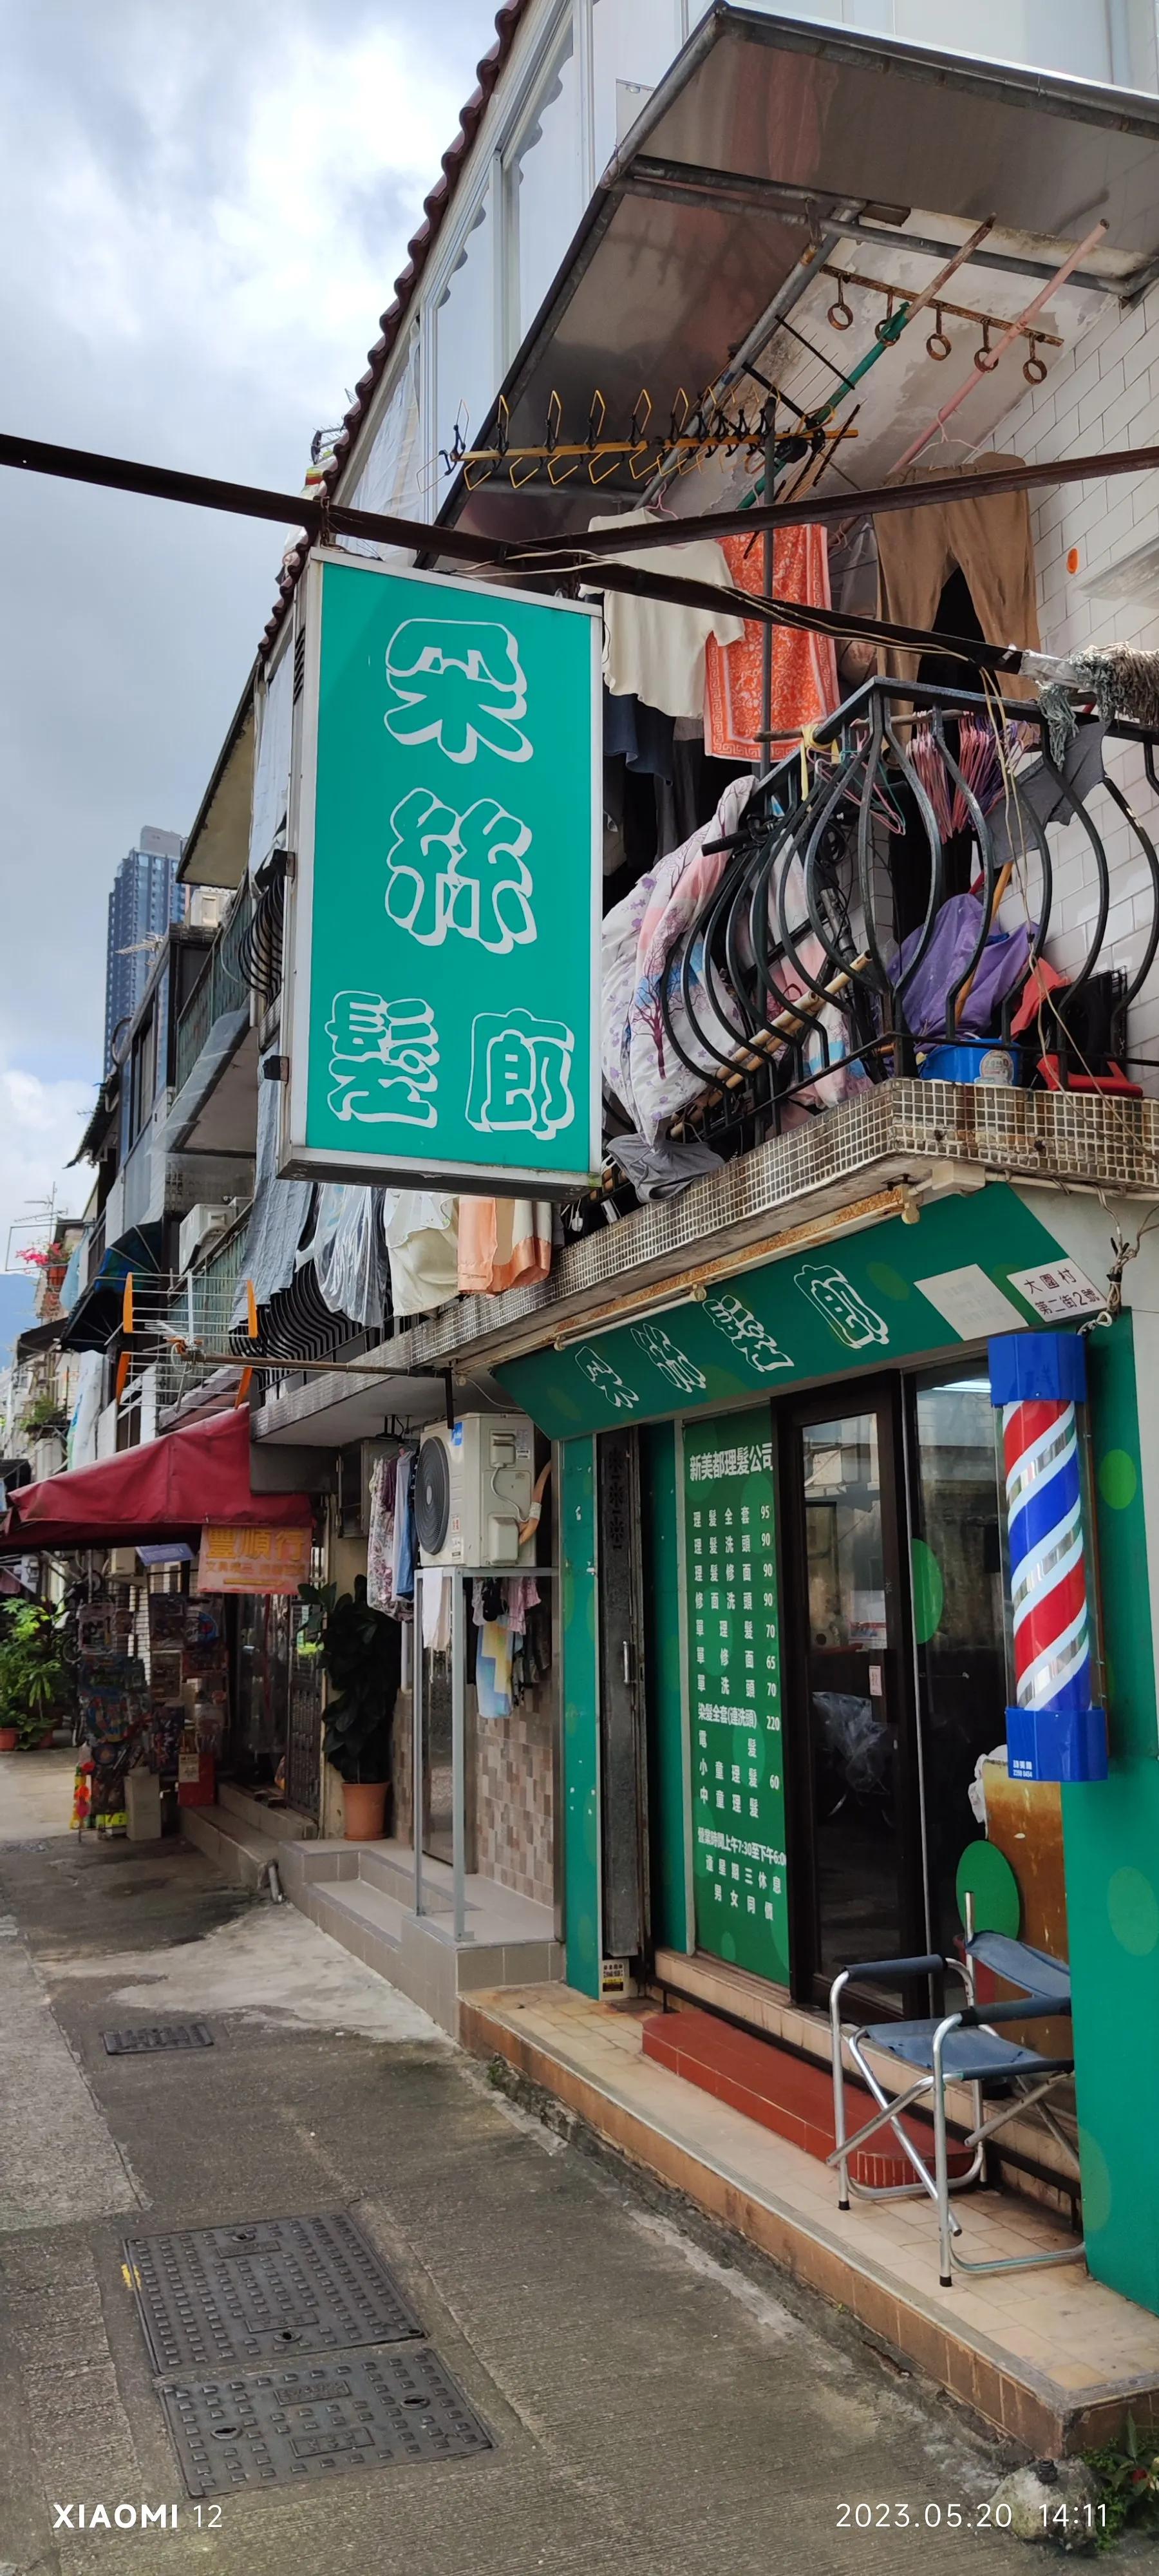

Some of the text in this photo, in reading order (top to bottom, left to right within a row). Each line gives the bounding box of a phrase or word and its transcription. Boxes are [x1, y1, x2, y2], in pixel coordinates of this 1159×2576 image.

[690, 1442, 773, 1482] 新美都理髮公司
[693, 1505, 770, 1528] 理髮全套 95
[206, 1528, 305, 1562] 豐順行
[694, 1532, 771, 1555] 理髮洗頭 90
[694, 1563, 773, 1582] 理髮修面 90
[695, 1591, 773, 1611] 修面洗頭 90
[696, 1619, 776, 1640] 單理髮 70
[697, 1646, 776, 1670] 單修面 65
[697, 1674, 777, 1698] 單洗頭 70
[766, 1715, 781, 1732] 220
[769, 1774, 780, 1790] 60
